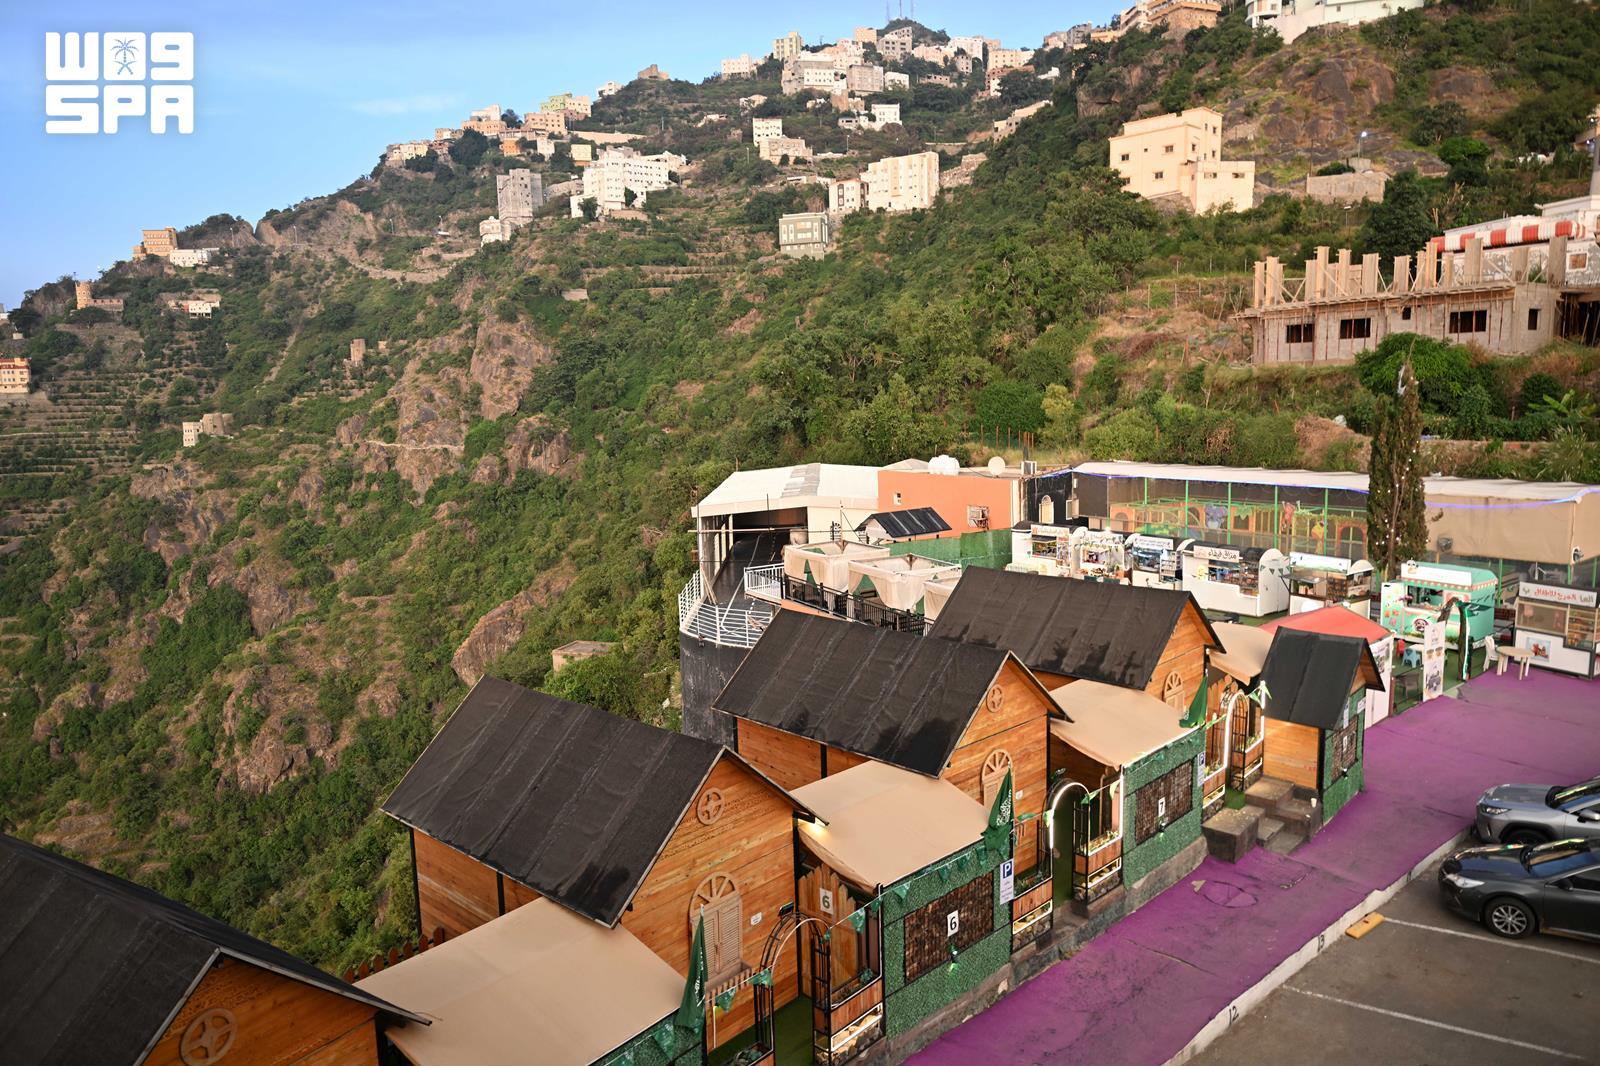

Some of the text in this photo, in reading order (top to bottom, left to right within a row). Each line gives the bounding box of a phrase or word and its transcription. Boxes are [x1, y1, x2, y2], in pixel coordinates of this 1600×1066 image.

[822, 895, 831, 909] 6
[949, 916, 957, 931] 6
[1317, 934, 1325, 953] 13
[1229, 1005, 1239, 1026] 12
